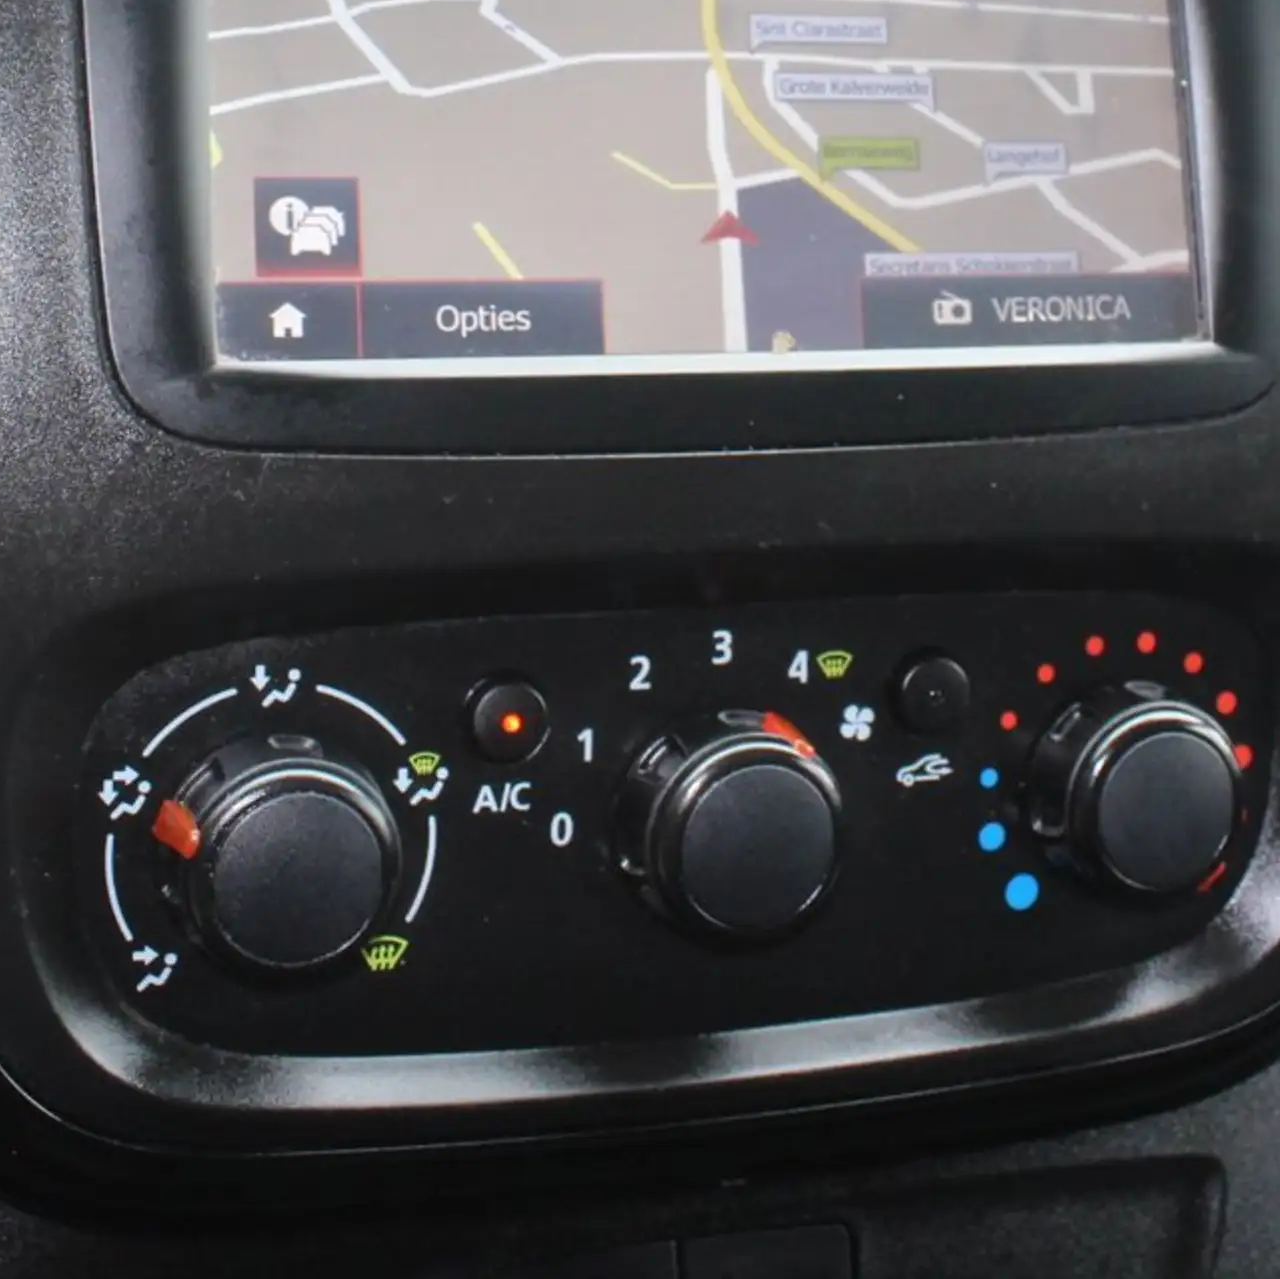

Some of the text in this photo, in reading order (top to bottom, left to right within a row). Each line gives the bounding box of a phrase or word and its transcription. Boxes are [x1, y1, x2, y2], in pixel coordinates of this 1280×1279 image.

[780, 77, 826, 95] Grote
[436, 304, 532, 338] Opties
[991, 294, 1132, 322] VERONICA
[711, 630, 733, 665] 3
[629, 655, 652, 690] 2
[787, 650, 809, 684] 4
[577, 728, 594, 762] 1
[472, 782, 532, 814] A/C
[550, 813, 574, 847] 0
